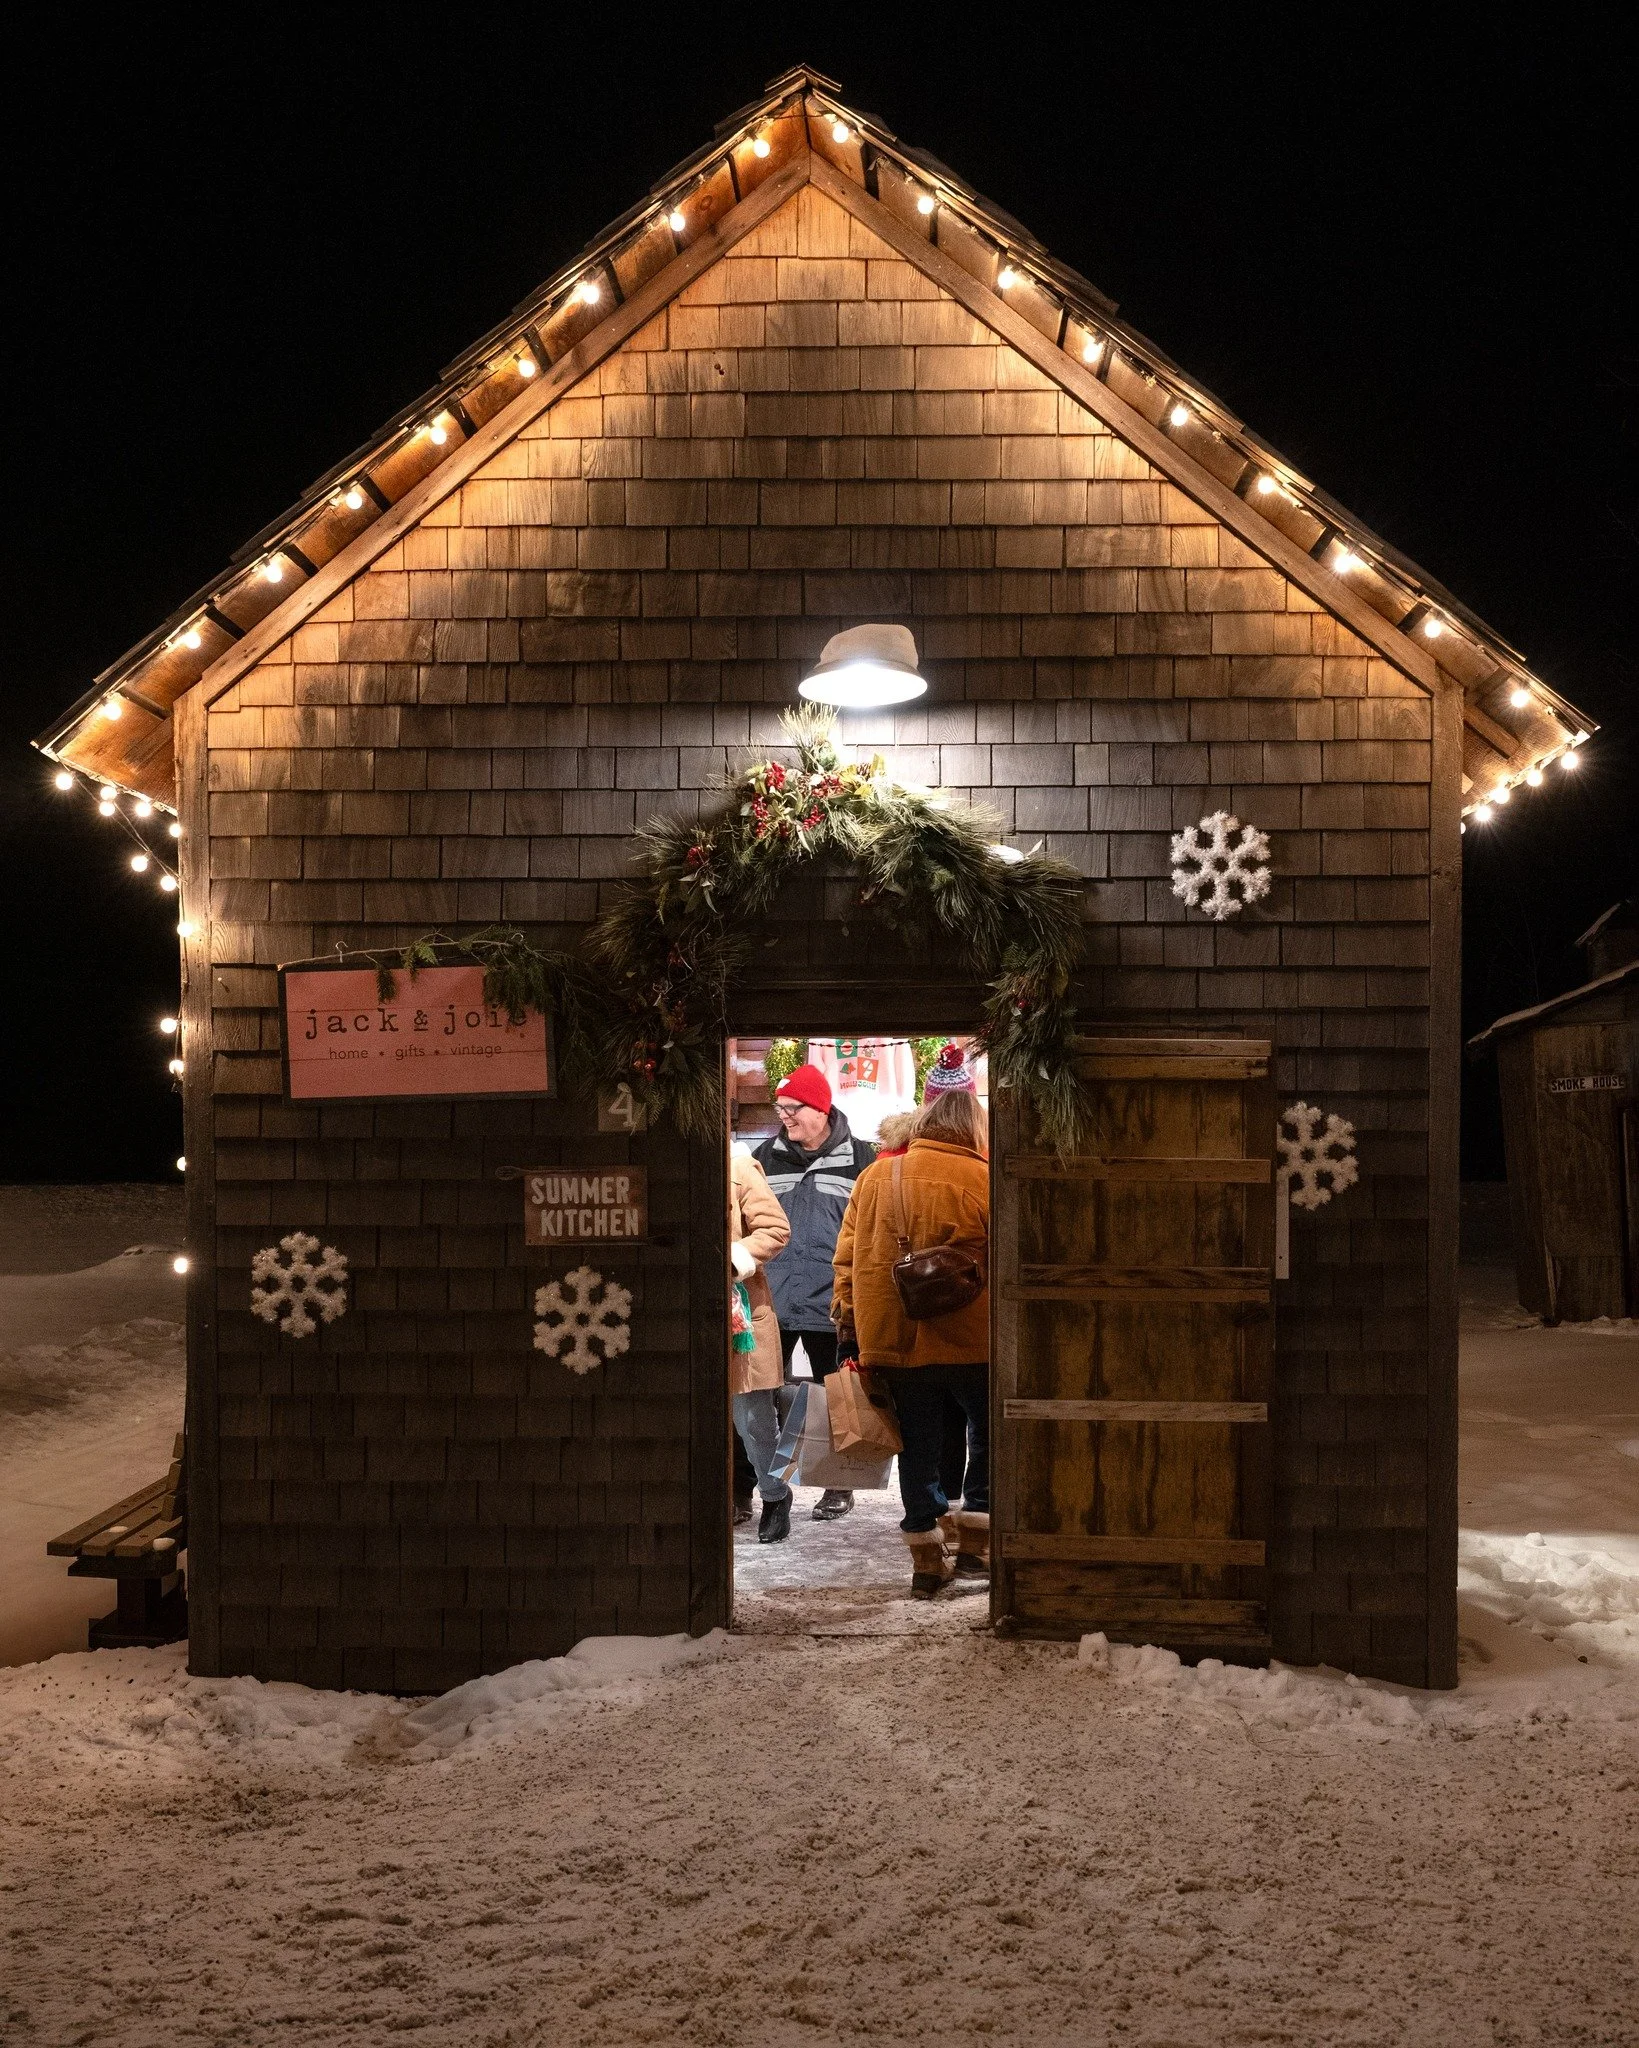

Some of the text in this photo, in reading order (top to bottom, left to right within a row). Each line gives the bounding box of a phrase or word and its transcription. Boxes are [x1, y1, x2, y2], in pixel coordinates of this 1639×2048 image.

[305, 1008, 399, 1040] jack
[413, 1009, 428, 1032] &
[329, 1043, 502, 1061] home gifts vintage
[1551, 1075, 1625, 1092] SMOKE HOUSE
[608, 1083, 635, 1127] 4
[530, 1176, 630, 1205] SUMMER
[540, 1208, 639, 1237] KITCHEN
